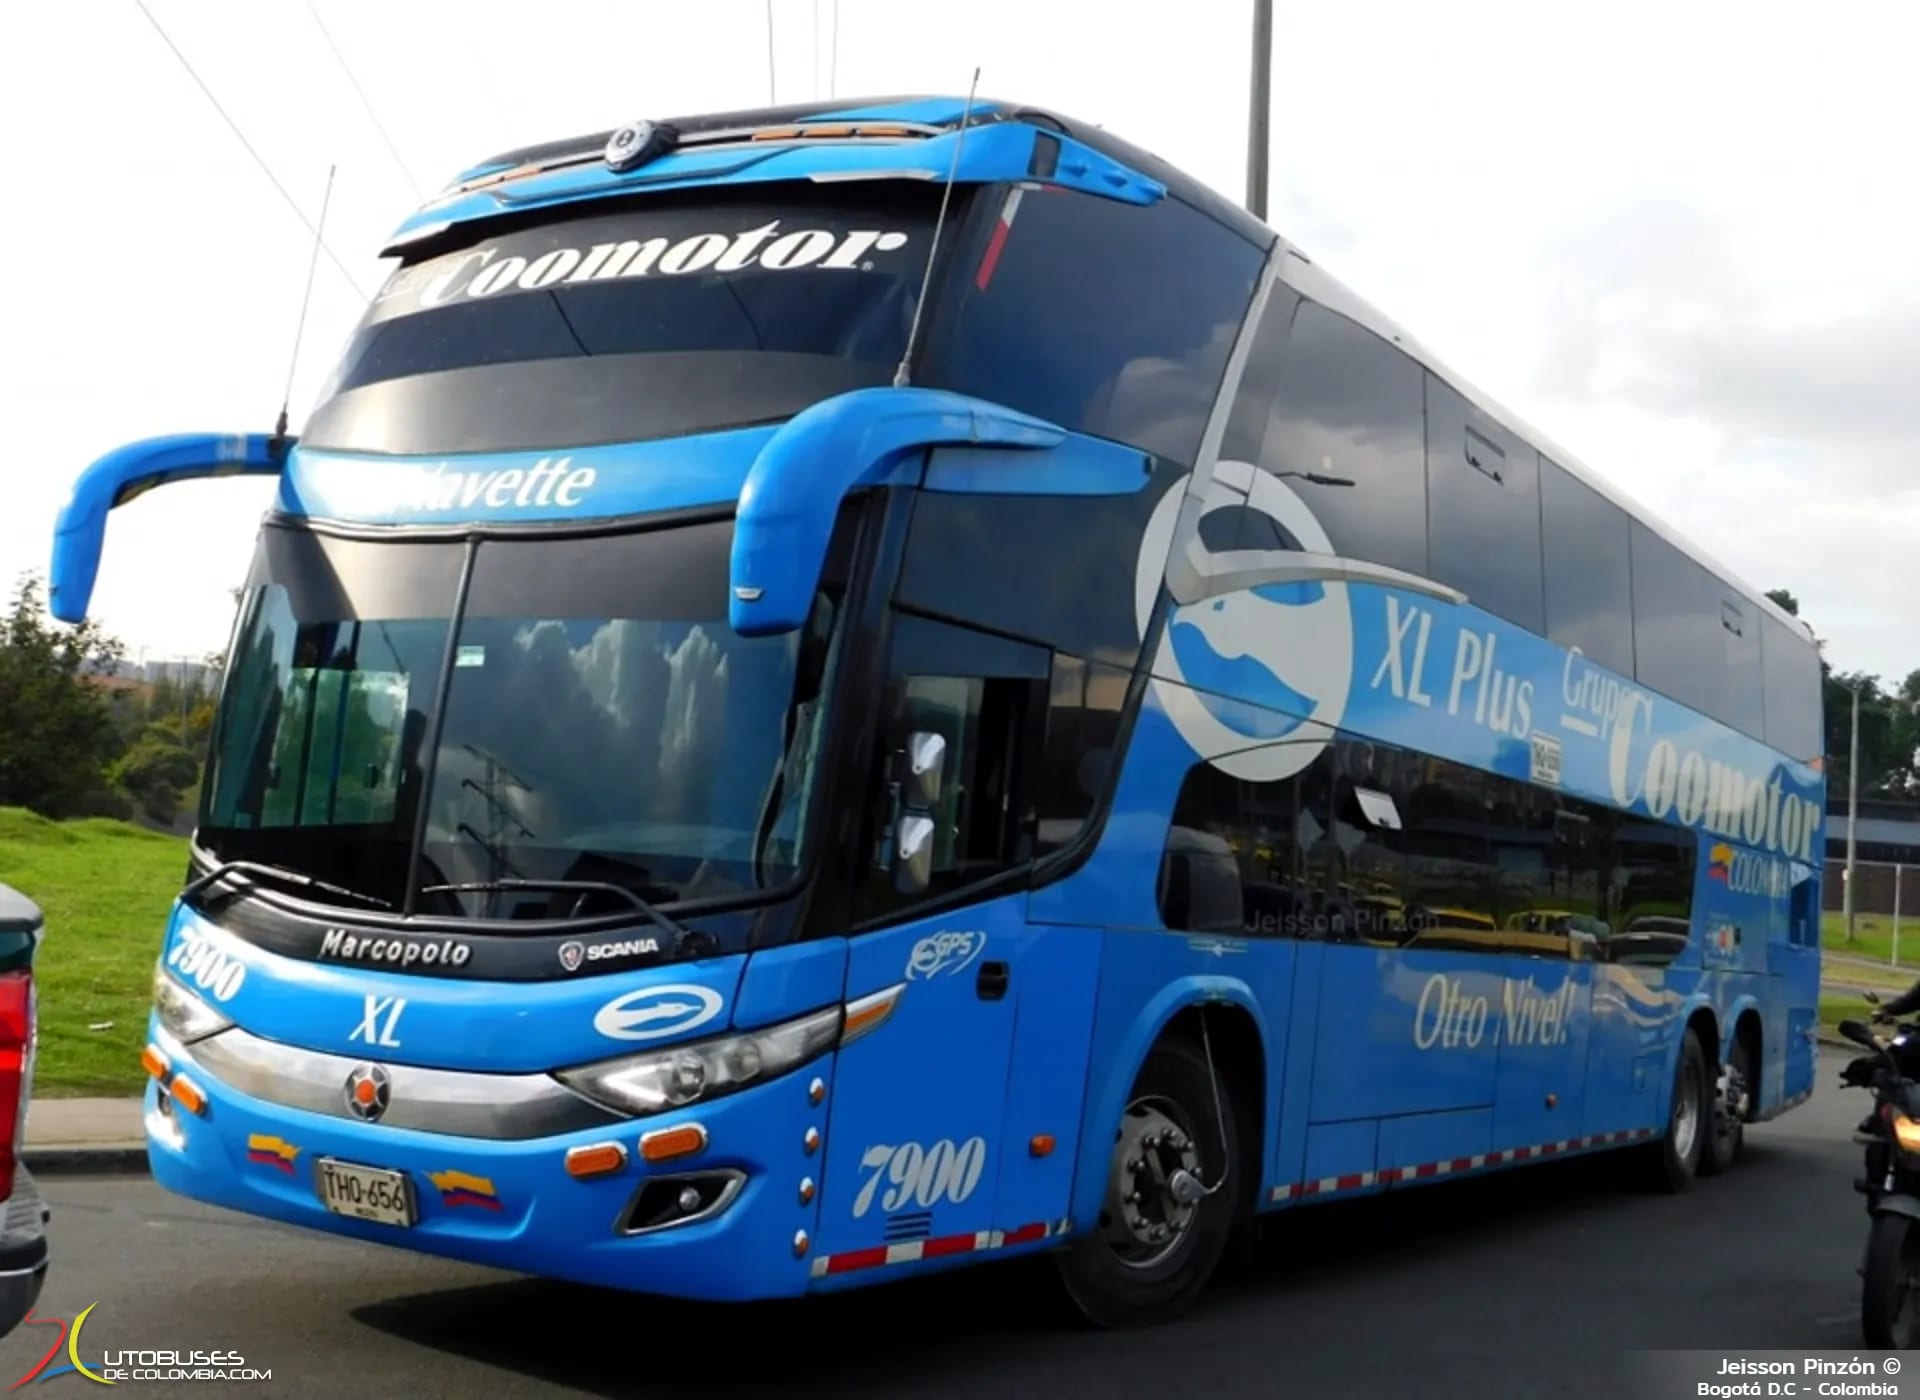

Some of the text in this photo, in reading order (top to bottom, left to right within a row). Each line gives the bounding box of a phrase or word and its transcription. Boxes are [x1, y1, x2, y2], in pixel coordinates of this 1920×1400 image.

[419, 218, 909, 306] Coomotor
[1371, 595, 1534, 740] XL Plus
[1610, 691, 1821, 862] Coomotor
[167, 925, 247, 1002] 7900
[320, 928, 472, 966] Marcopolo
[587, 938, 660, 961] SCANIA
[937, 931, 972, 957] GPS
[349, 993, 409, 1048] XL
[1412, 972, 1578, 1050] Otro Nivel!
[852, 1135, 987, 1219] 7900
